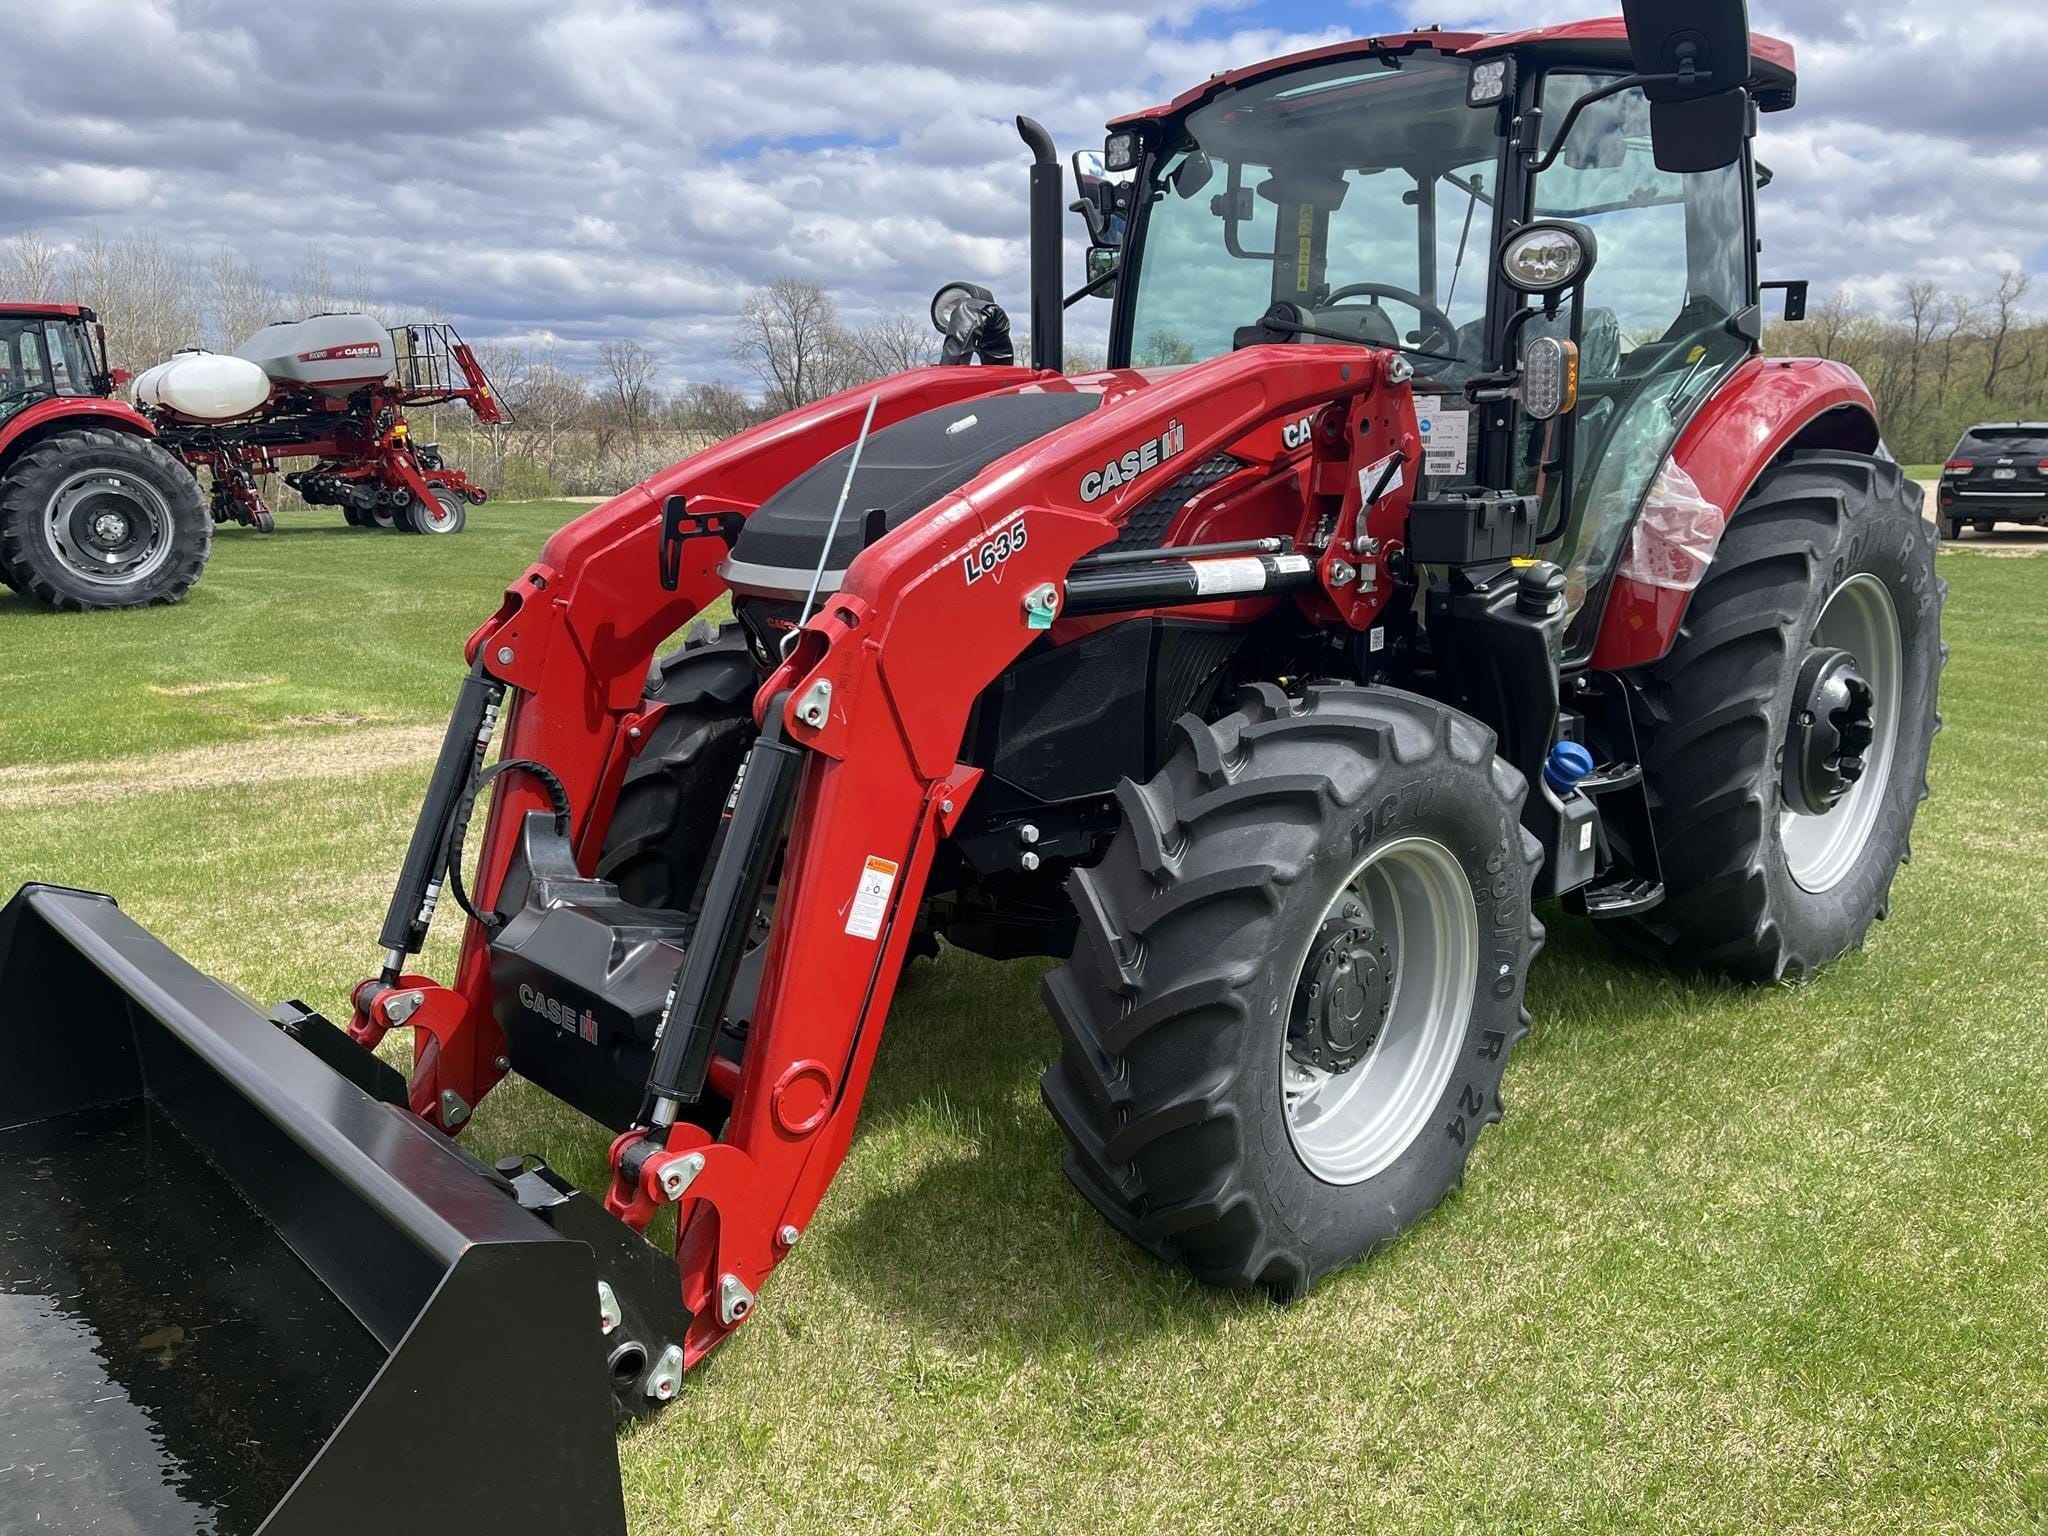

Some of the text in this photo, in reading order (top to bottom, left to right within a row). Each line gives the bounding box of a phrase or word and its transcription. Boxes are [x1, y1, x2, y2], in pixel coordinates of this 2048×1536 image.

[344, 347, 369, 356] CASE
[1282, 413, 1314, 448] CA
[1080, 438, 1159, 502] CASE
[964, 518, 1028, 586] L635
[519, 983, 577, 1033] CASE
[1477, 1027, 1507, 1062] R
[1445, 1083, 1484, 1147] 24
